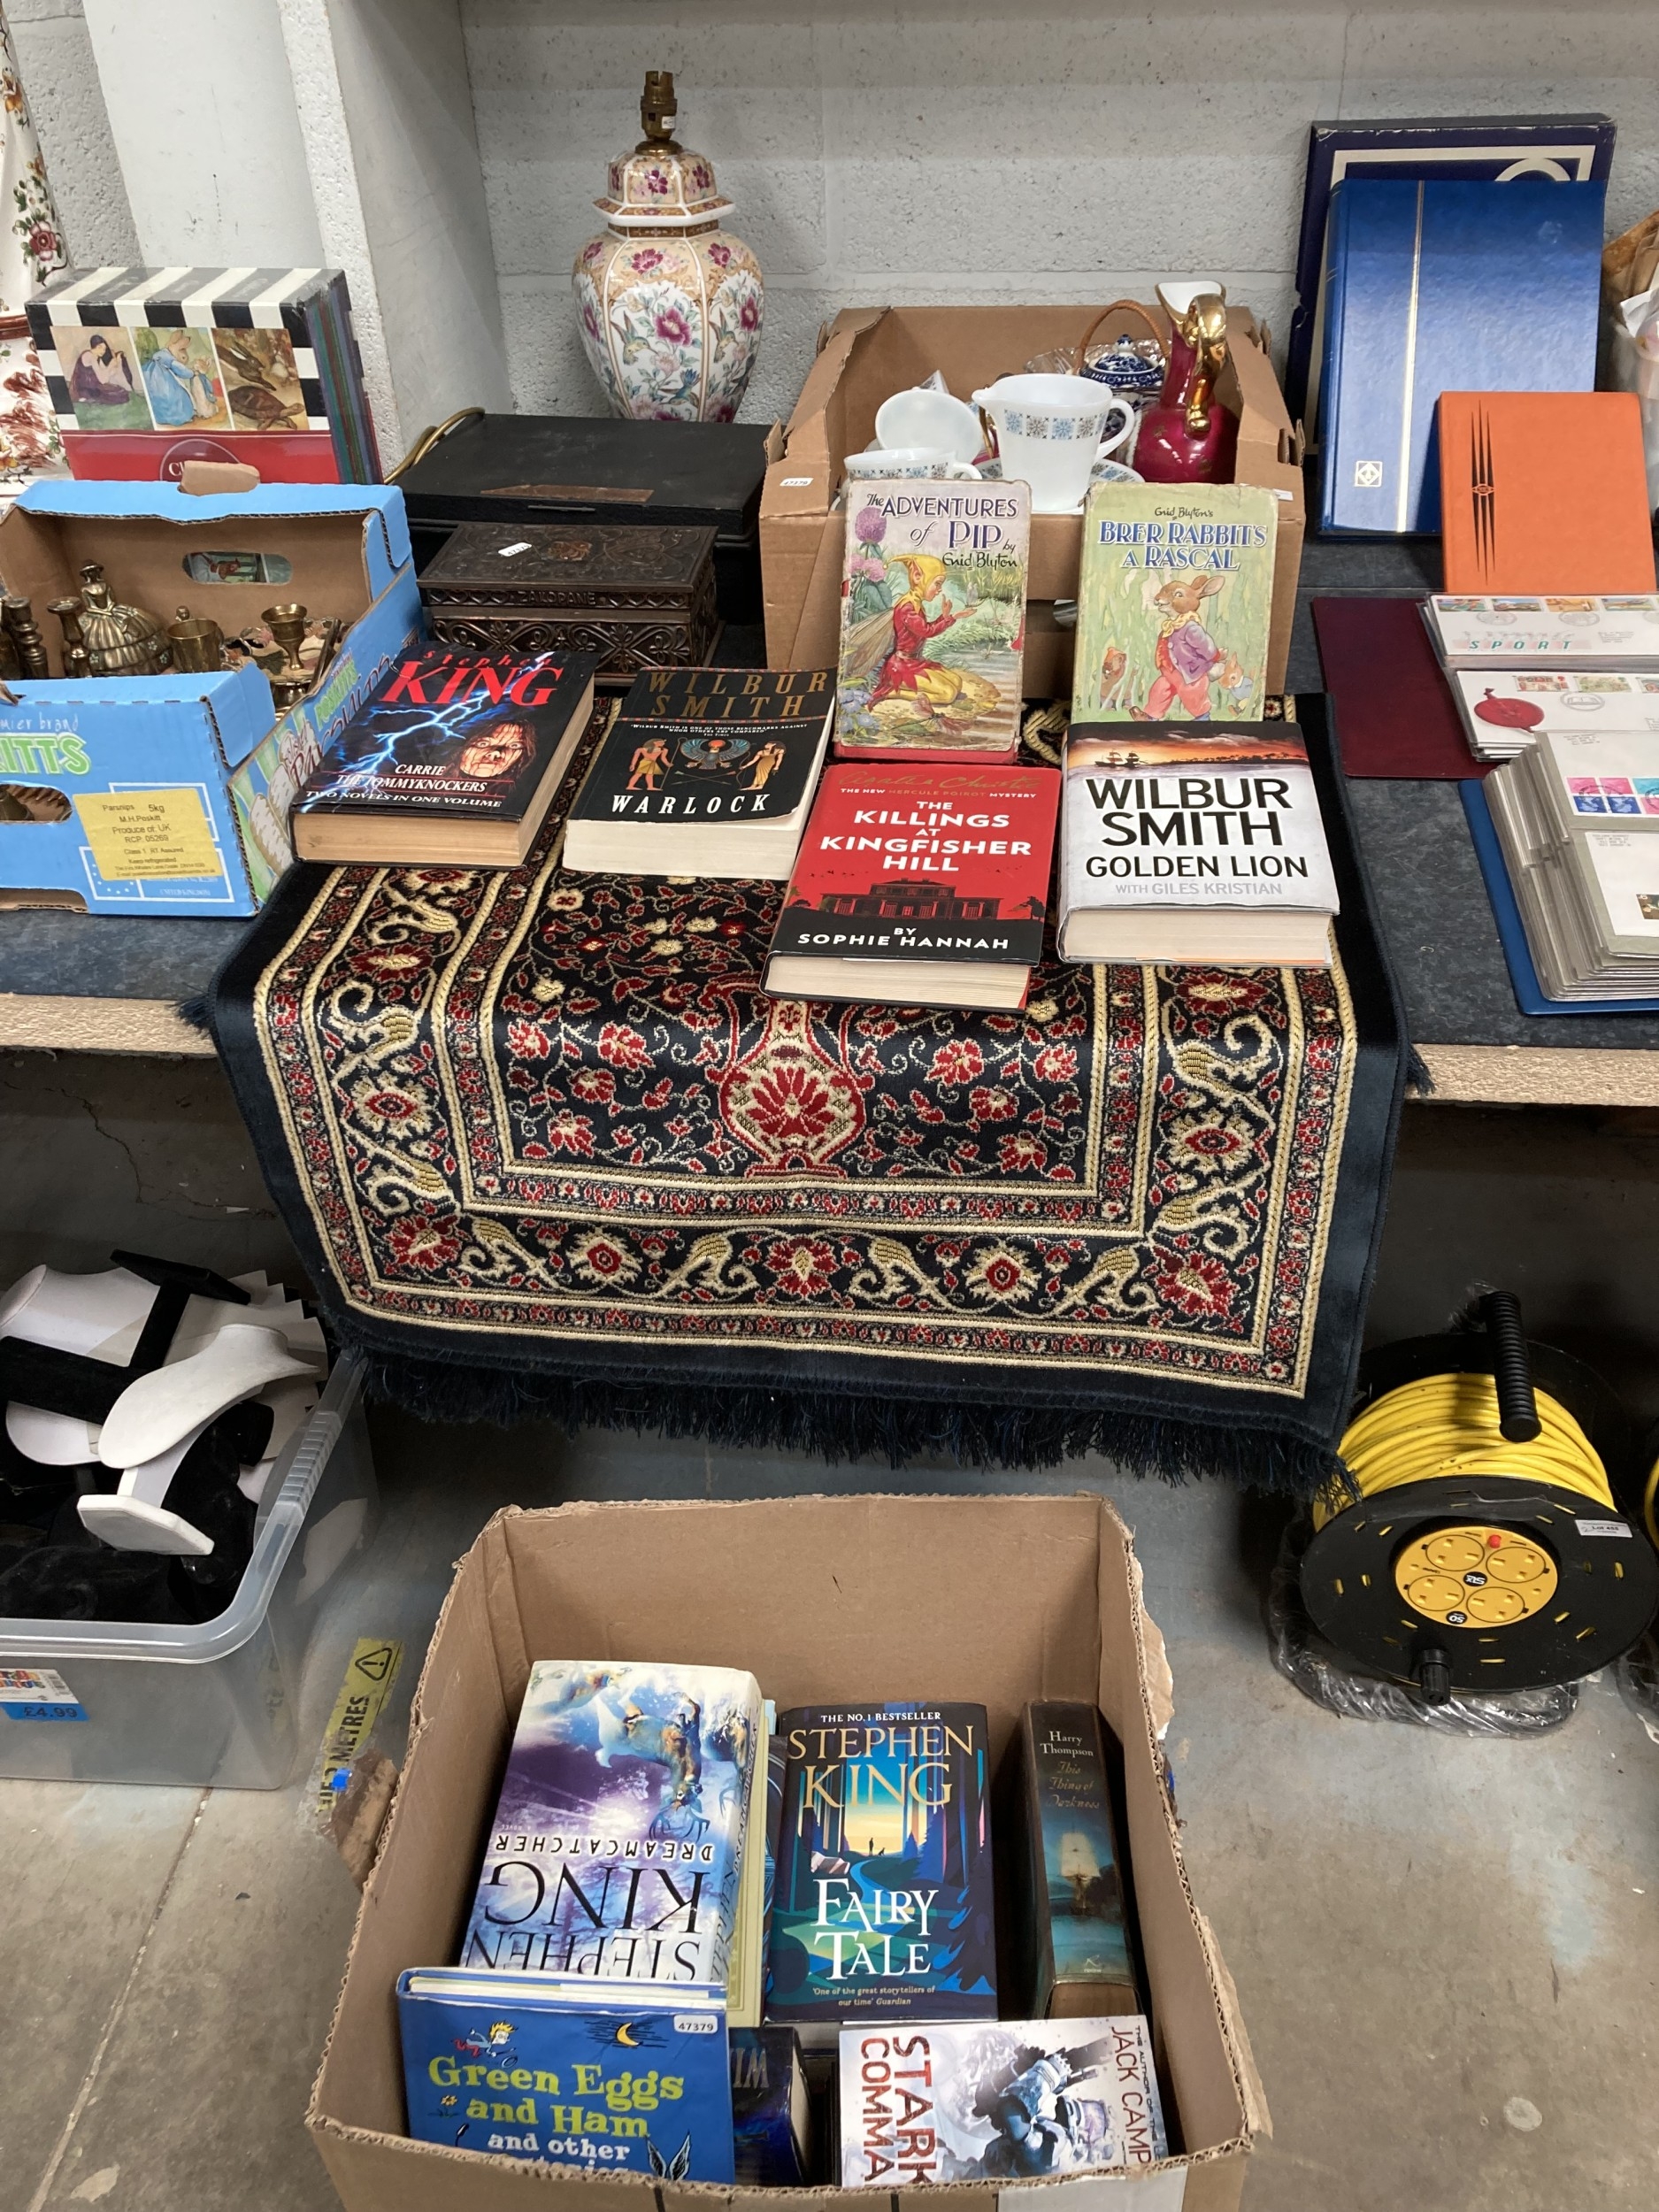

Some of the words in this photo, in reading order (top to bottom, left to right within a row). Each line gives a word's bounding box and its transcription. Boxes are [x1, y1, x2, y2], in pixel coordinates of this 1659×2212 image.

[866, 494, 884, 507] The
[881, 496, 1019, 518] ADVENTURES
[1154, 507, 1177, 520] Enid
[1178, 507, 1214, 518] Blyton's
[910, 521, 937, 546] of
[949, 520, 1002, 549] PIP
[1098, 520, 1164, 545] BRER
[1166, 522, 1268, 547] RABBIT'S
[1002, 542, 1016, 553] by
[1121, 549, 1139, 568] A
[1143, 545, 1240, 571] RASCAL
[943, 552, 973, 571] Enid
[976, 552, 1018, 568] Blyton
[1469, 641, 1572, 649] SPORT
[379, 661, 564, 706] KING
[649, 672, 828, 695] WILBUR
[650, 695, 805, 718] SMITH
[39, 711, 79, 732] brand
[396, 764, 446, 775] CARRIE
[335, 775, 361, 786] THE
[365, 775, 488, 792] TOMMYKNOCKERS
[1085, 778, 1294, 810] WILBUR
[149, 804, 165, 813] 5kg
[443, 798, 503, 808] VOLUME
[611, 794, 770, 815] WARLOCK
[916, 801, 954, 810] THE
[853, 810, 1010, 827] KILLINGS
[1101, 810, 1284, 846] SMITH
[916, 828, 941, 837] AT
[819, 836, 1033, 856] KINGFISHER
[882, 856, 959, 872] HILL
[1086, 856, 1220, 878] GOLDEN
[1231, 856, 1309, 878] LION
[1115, 884, 1148, 895] WITH
[1152, 882, 1200, 895] GILES
[1204, 882, 1283, 895] KRISTIAN
[797, 933, 890, 946] SOPHIE
[900, 937, 1010, 949] HANNAH
[24, 1707, 78, 1717] £4.99
[820, 1714, 843, 1723] THE
[847, 1713, 865, 1722] NO.
[875, 1712, 941, 1721] BESTSELLER
[329, 1696, 370, 1763] METRES
[1048, 1731, 1083, 1747] Harry
[787, 1725, 974, 1760] STEPHEN
[1039, 1743, 1094, 1758] Thompson
[1057, 1761, 1081, 1774] This
[803, 1762, 952, 1809] KING
[495, 1835, 713, 1862] DREAMCATCHER
[484, 1861, 711, 1935] KING
[468, 1929, 701, 1982] STEPHEN
[857, 1987, 878, 1996] great
[879, 1986, 925, 1995] storytellers
[926, 1985, 935, 1993] of
[678, 2022, 715, 2032] 47379
[1111, 2026, 1140, 2082] JACK
[1139, 2051, 1150, 2094] AUTHOR
[428, 2055, 561, 2095] Green
[572, 2063, 685, 2112] Eggs
[1146, 2098, 1154, 2113] OF
[466, 2097, 539, 2124] and
[549, 2104, 651, 2138] Ham
[1148, 2118, 1158, 2142] THE
[488, 2132, 540, 2151] and
[548, 2137, 631, 2160] other
